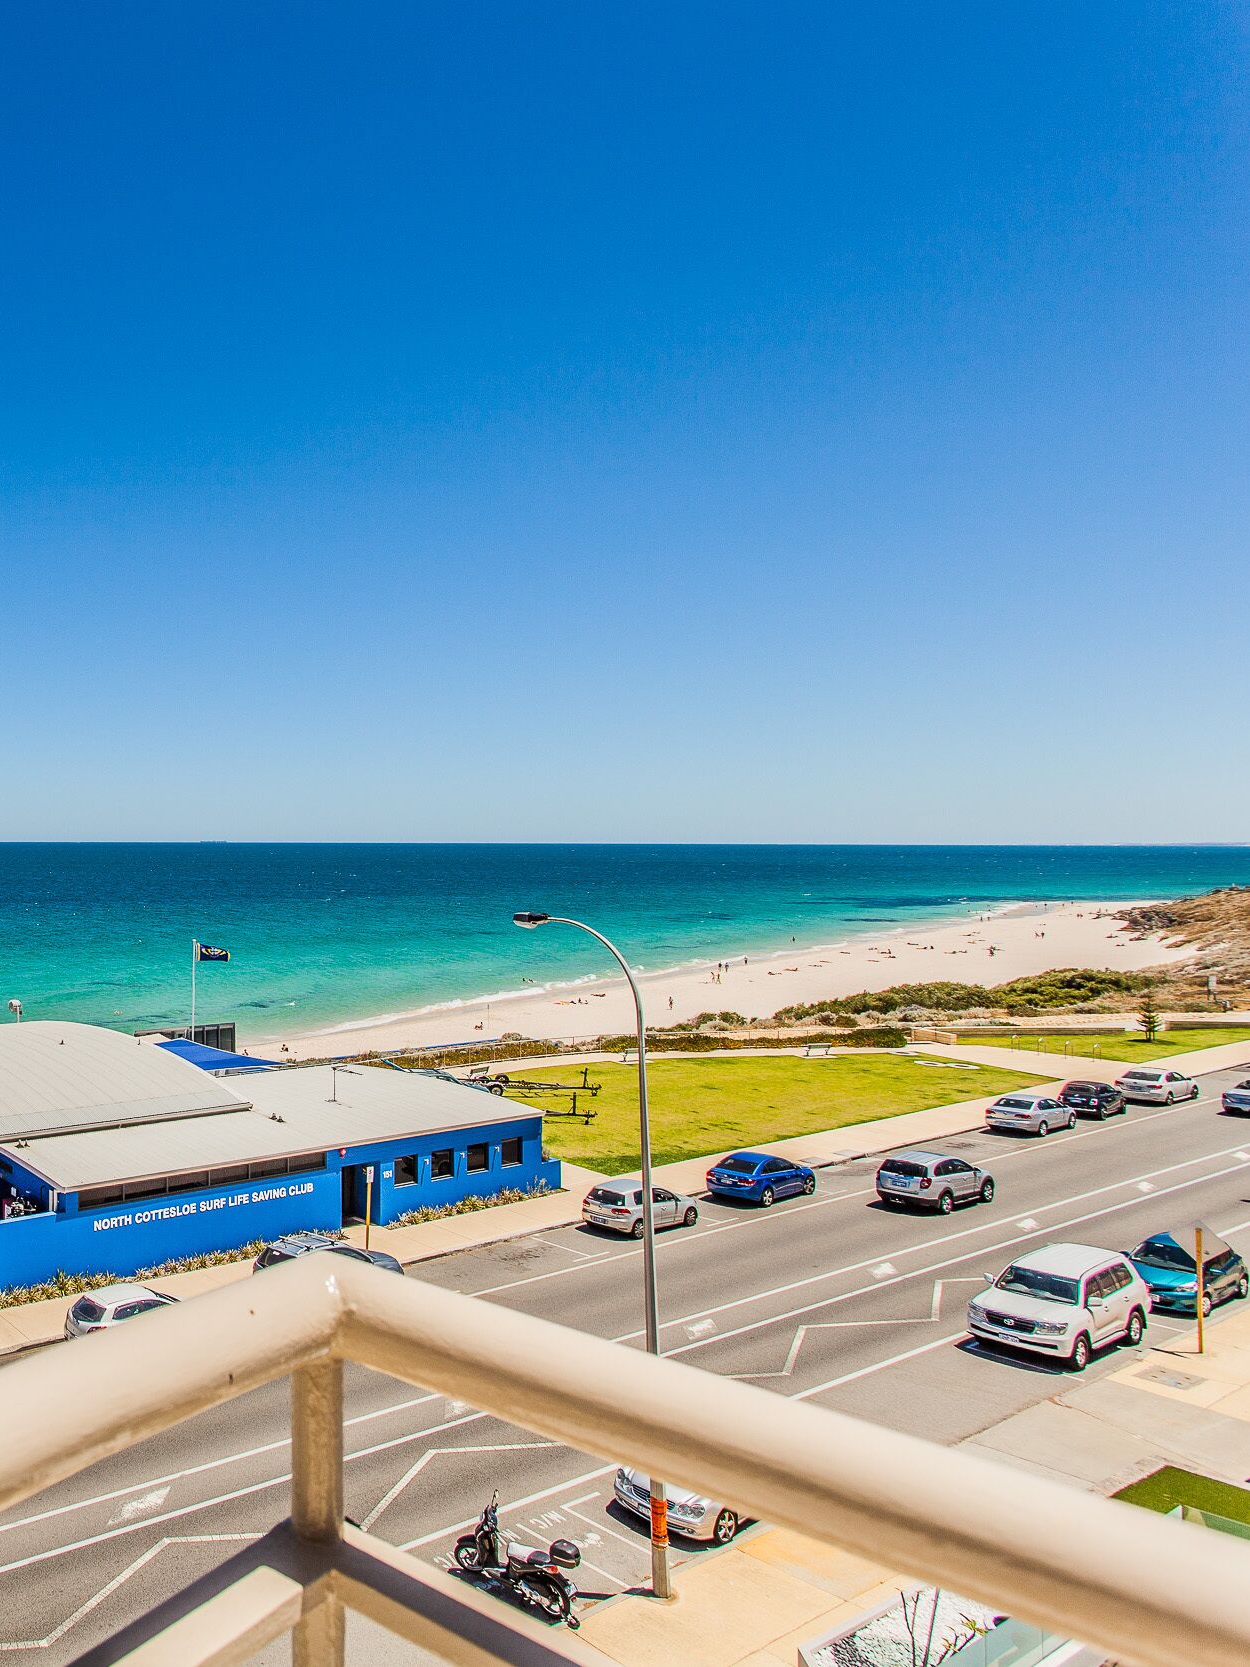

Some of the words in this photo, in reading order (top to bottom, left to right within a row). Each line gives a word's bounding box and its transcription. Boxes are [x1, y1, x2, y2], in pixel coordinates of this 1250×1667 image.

[382, 1169, 393, 1179] 151
[93, 1213, 132, 1232] NORTH
[134, 1202, 197, 1225] COTTESLOE
[199, 1197, 227, 1213] SURF
[228, 1193, 250, 1208] LIFE
[251, 1186, 287, 1204] SAVING
[288, 1182, 315, 1197] CLUB
